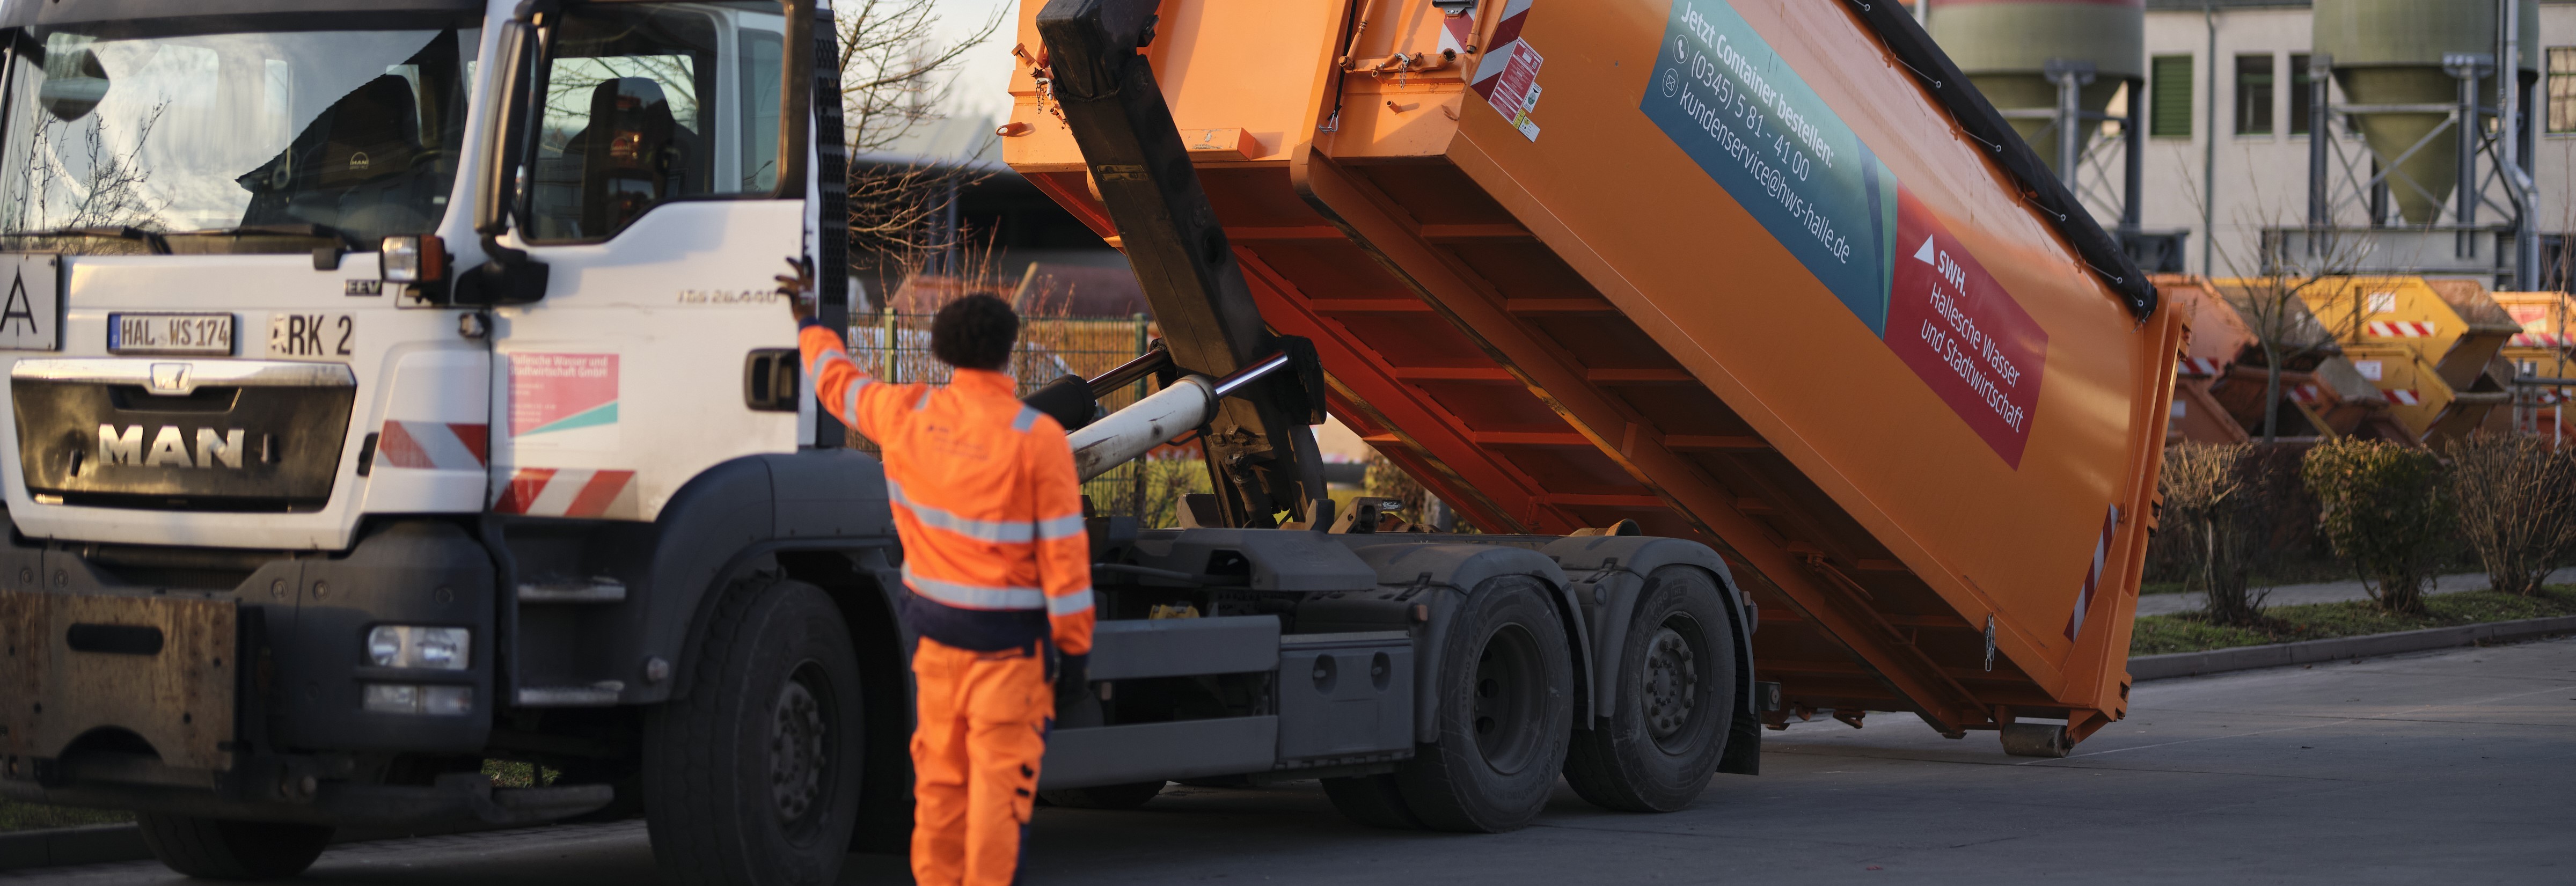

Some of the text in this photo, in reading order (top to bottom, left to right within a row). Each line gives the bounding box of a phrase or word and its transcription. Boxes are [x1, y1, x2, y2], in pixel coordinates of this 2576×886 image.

[1681, 1, 1834, 168] Jetzt Container bestellen:
[1692, 50, 1733, 109] (0345)
[1735, 93, 1746, 118] 5
[1746, 105, 1763, 138] 81
[1774, 134, 1790, 164] 41
[1792, 150, 1810, 181] 00
[1680, 82, 1850, 264] kundenservice@hws-halle.de
[0, 263, 37, 334] A
[349, 281, 382, 294] EEV
[1938, 250, 1966, 297] SWH.
[122, 318, 155, 346] HAL
[336, 314, 352, 355] 2
[553, 356, 587, 367] Wasser
[589, 357, 609, 367] und
[1930, 282, 2020, 387] Hallesche Wasser
[1921, 319, 2023, 433] und Stadtwirtschaft
[99, 423, 245, 468] MAN
